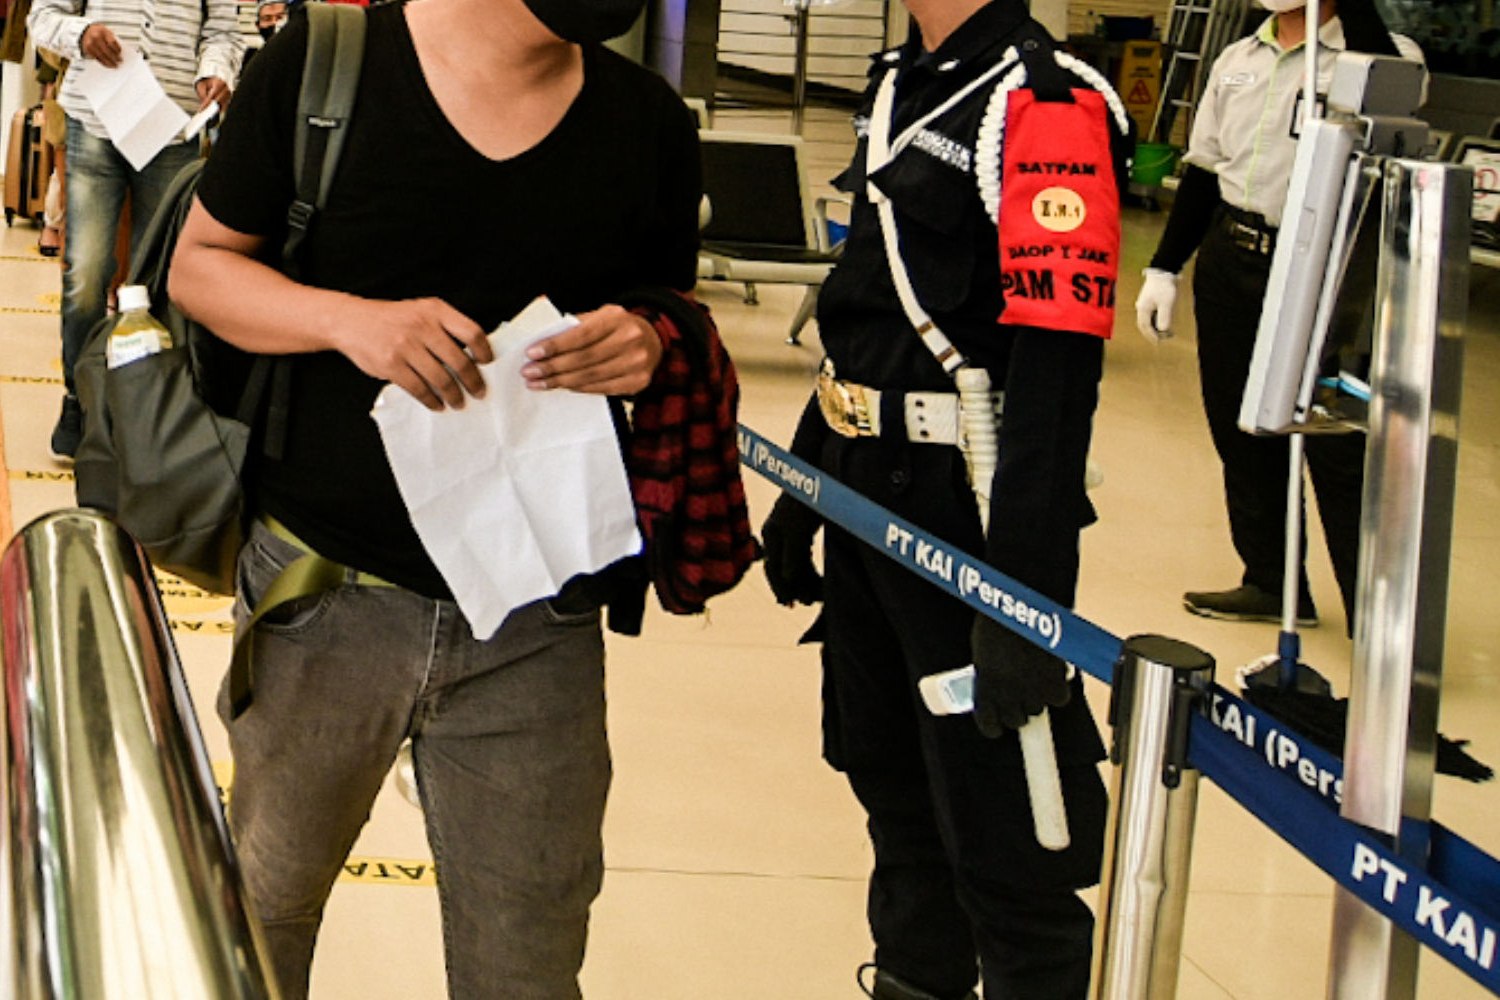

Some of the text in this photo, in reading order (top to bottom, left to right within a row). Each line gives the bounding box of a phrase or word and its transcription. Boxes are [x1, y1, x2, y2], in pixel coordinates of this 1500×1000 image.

[1017, 162, 1097, 176] SATPAM
[752, 441, 821, 504] (Persero)
[885, 522, 1062, 649] PT KAI (Persero)
[1351, 841, 1497, 971] PT KAI
